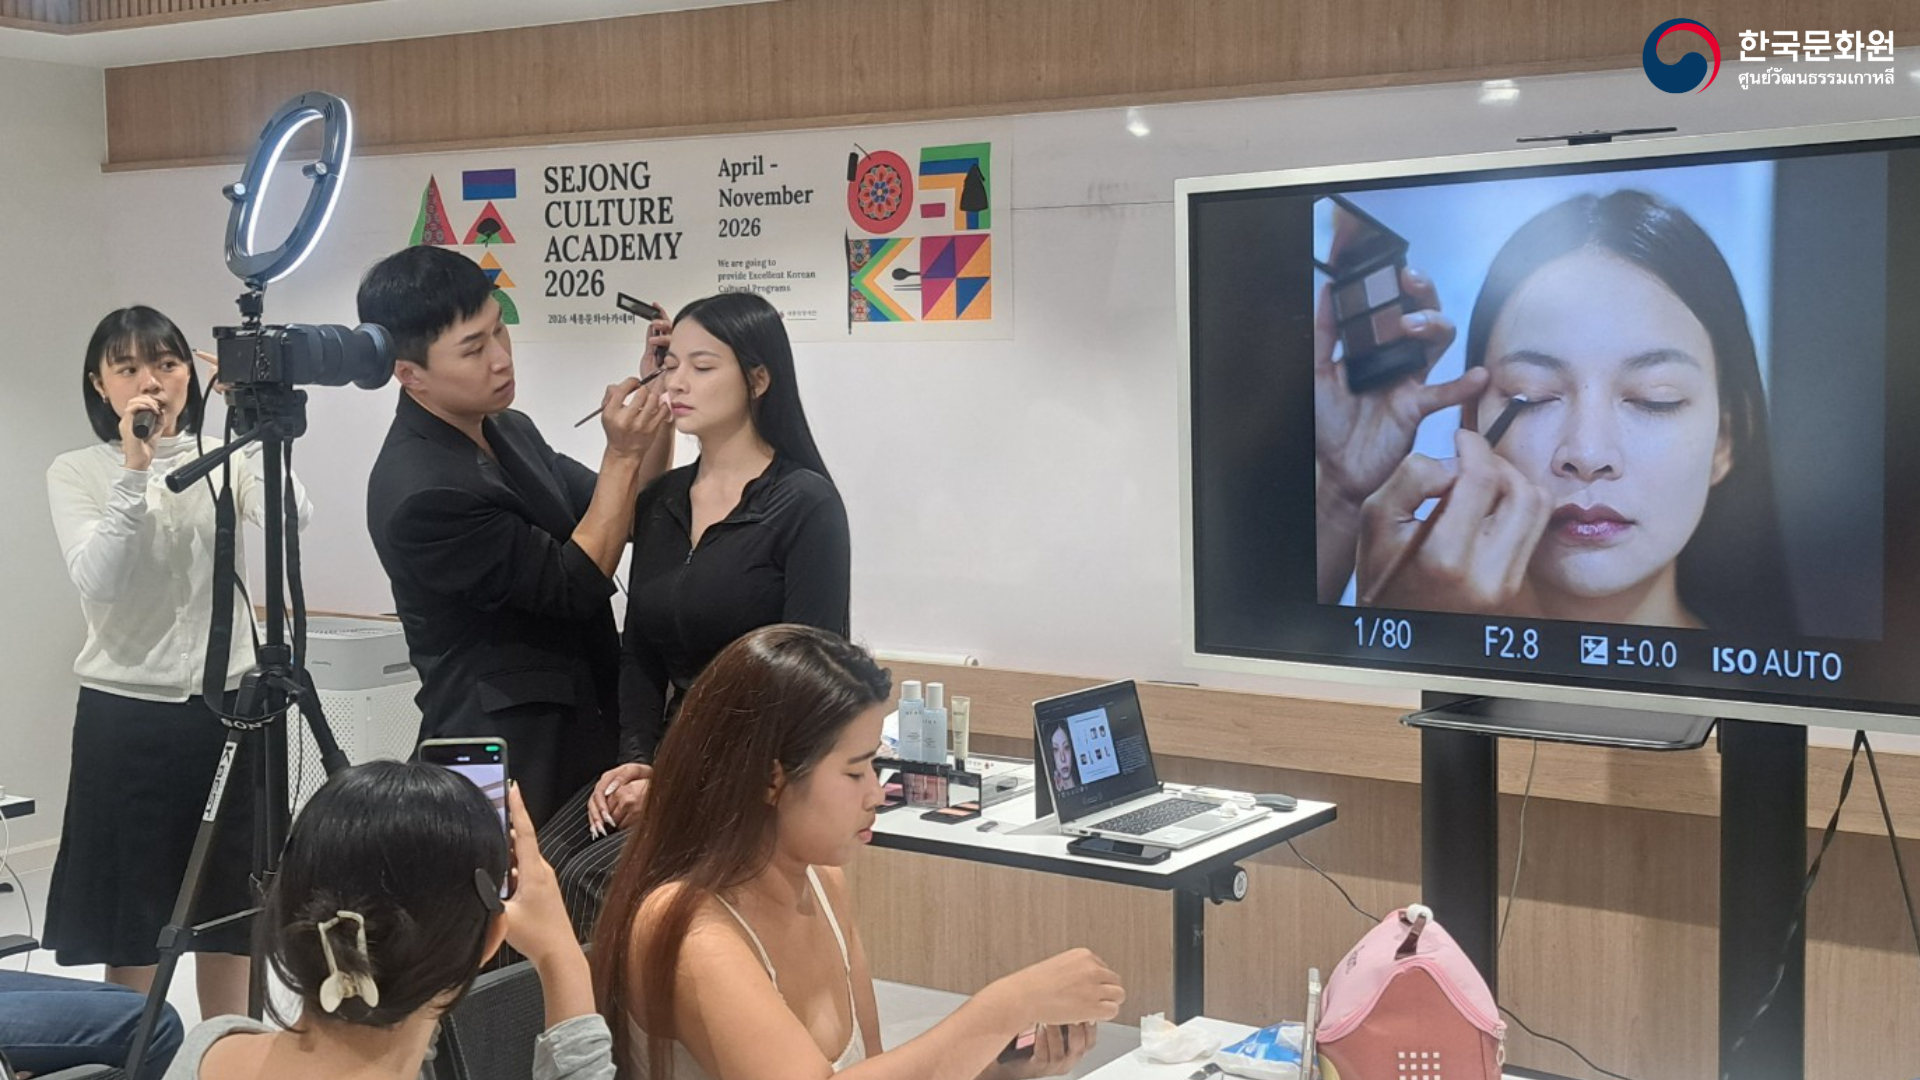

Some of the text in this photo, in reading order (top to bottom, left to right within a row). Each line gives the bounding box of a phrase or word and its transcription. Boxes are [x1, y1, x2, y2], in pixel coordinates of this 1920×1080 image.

[544, 161, 651, 194] SEJONG
[718, 155, 764, 181] April
[718, 184, 814, 208] November
[544, 197, 674, 228] CULTURE
[718, 218, 761, 238] 2026
[544, 232, 683, 263] ACADEMY
[717, 259, 730, 268] We
[745, 259, 767, 270] going
[768, 259, 777, 267] to
[717, 270, 816, 283] provide Excellent Korean
[544, 269, 605, 297] 2026
[717, 284, 791, 295] Cultural Programs
[1354, 617, 1412, 650] 1/80
[1485, 625, 1539, 660] F2.8
[1713, 646, 1757, 674] ISO
[1762, 648, 1842, 682] AUTO
